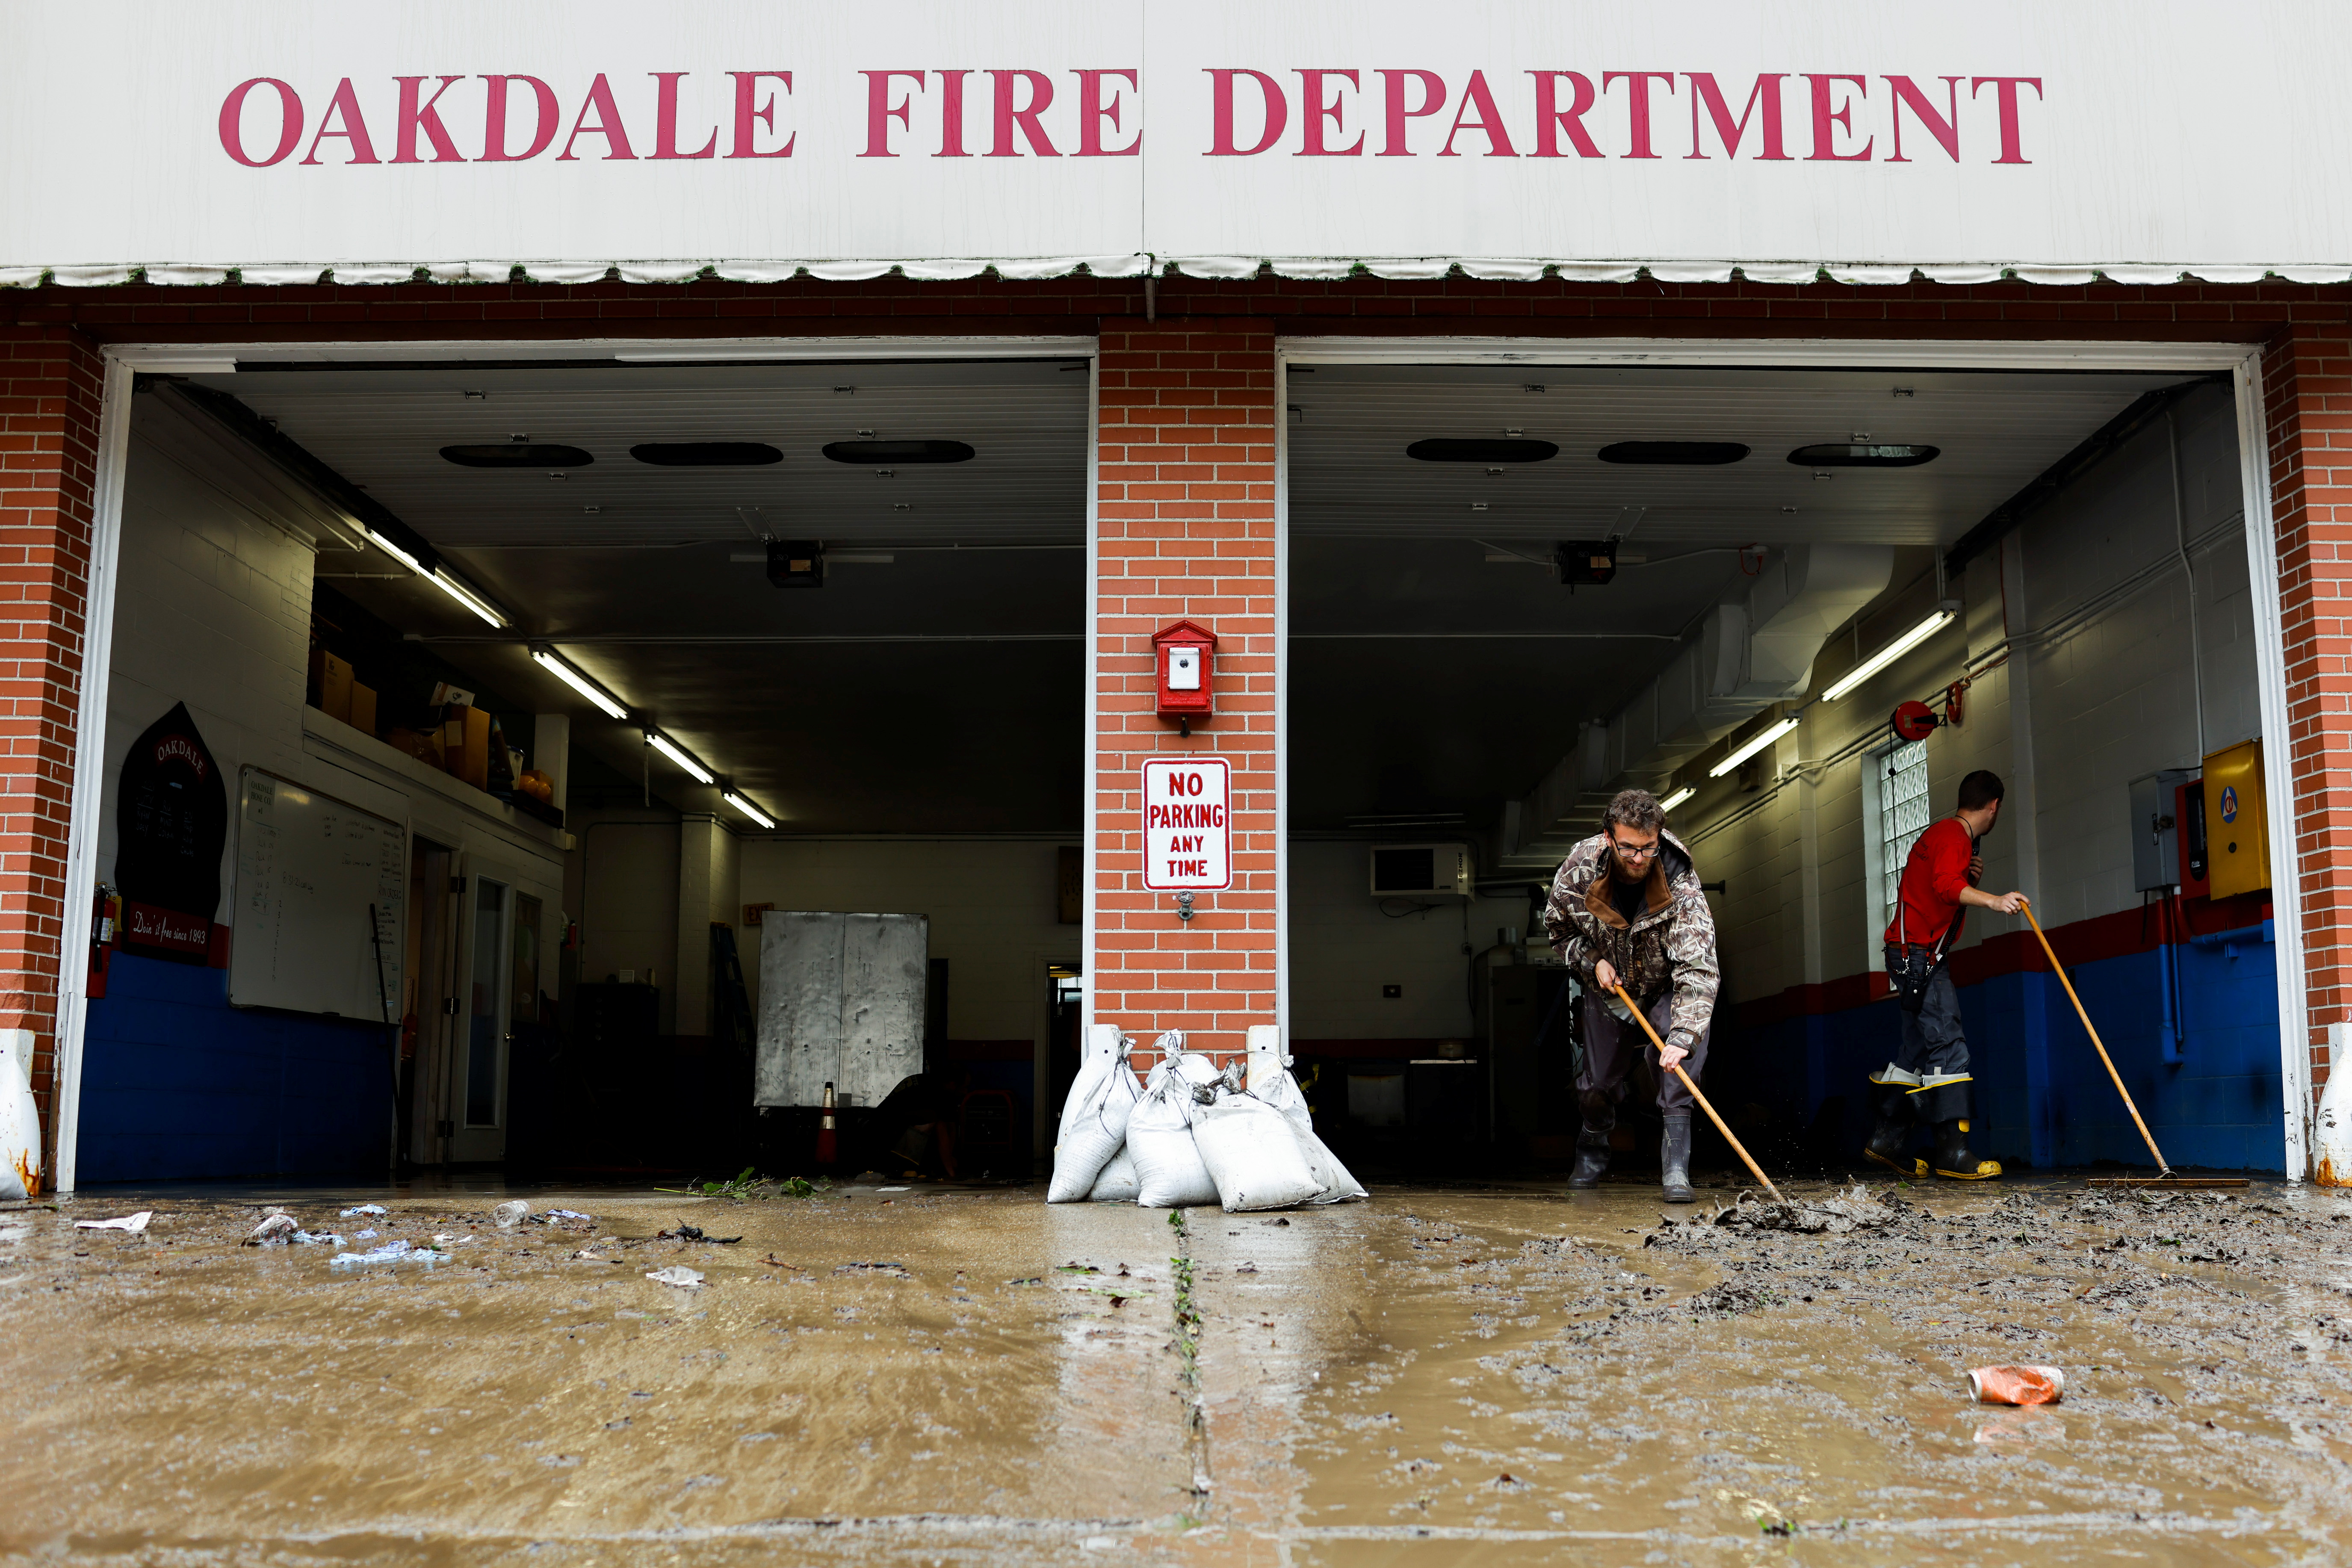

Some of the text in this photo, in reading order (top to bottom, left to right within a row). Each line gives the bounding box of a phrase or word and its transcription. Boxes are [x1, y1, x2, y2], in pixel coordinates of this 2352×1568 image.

[219, 69, 2042, 166] OAKDALE FIRE DEPARTMENT
[158, 740, 203, 774] OAKDALE
[251, 781, 272, 795] OAKDALE
[1170, 773, 1203, 796] NO
[251, 791, 263, 803] HOSE
[1150, 804, 1223, 828] PARKING
[1171, 836, 1203, 852] ANY
[1167, 860, 1207, 877] TIME
[155, 922, 160, 936] it
[159, 917, 171, 942] free
[173, 928, 186, 941] since
[189, 928, 205, 944] 1893
